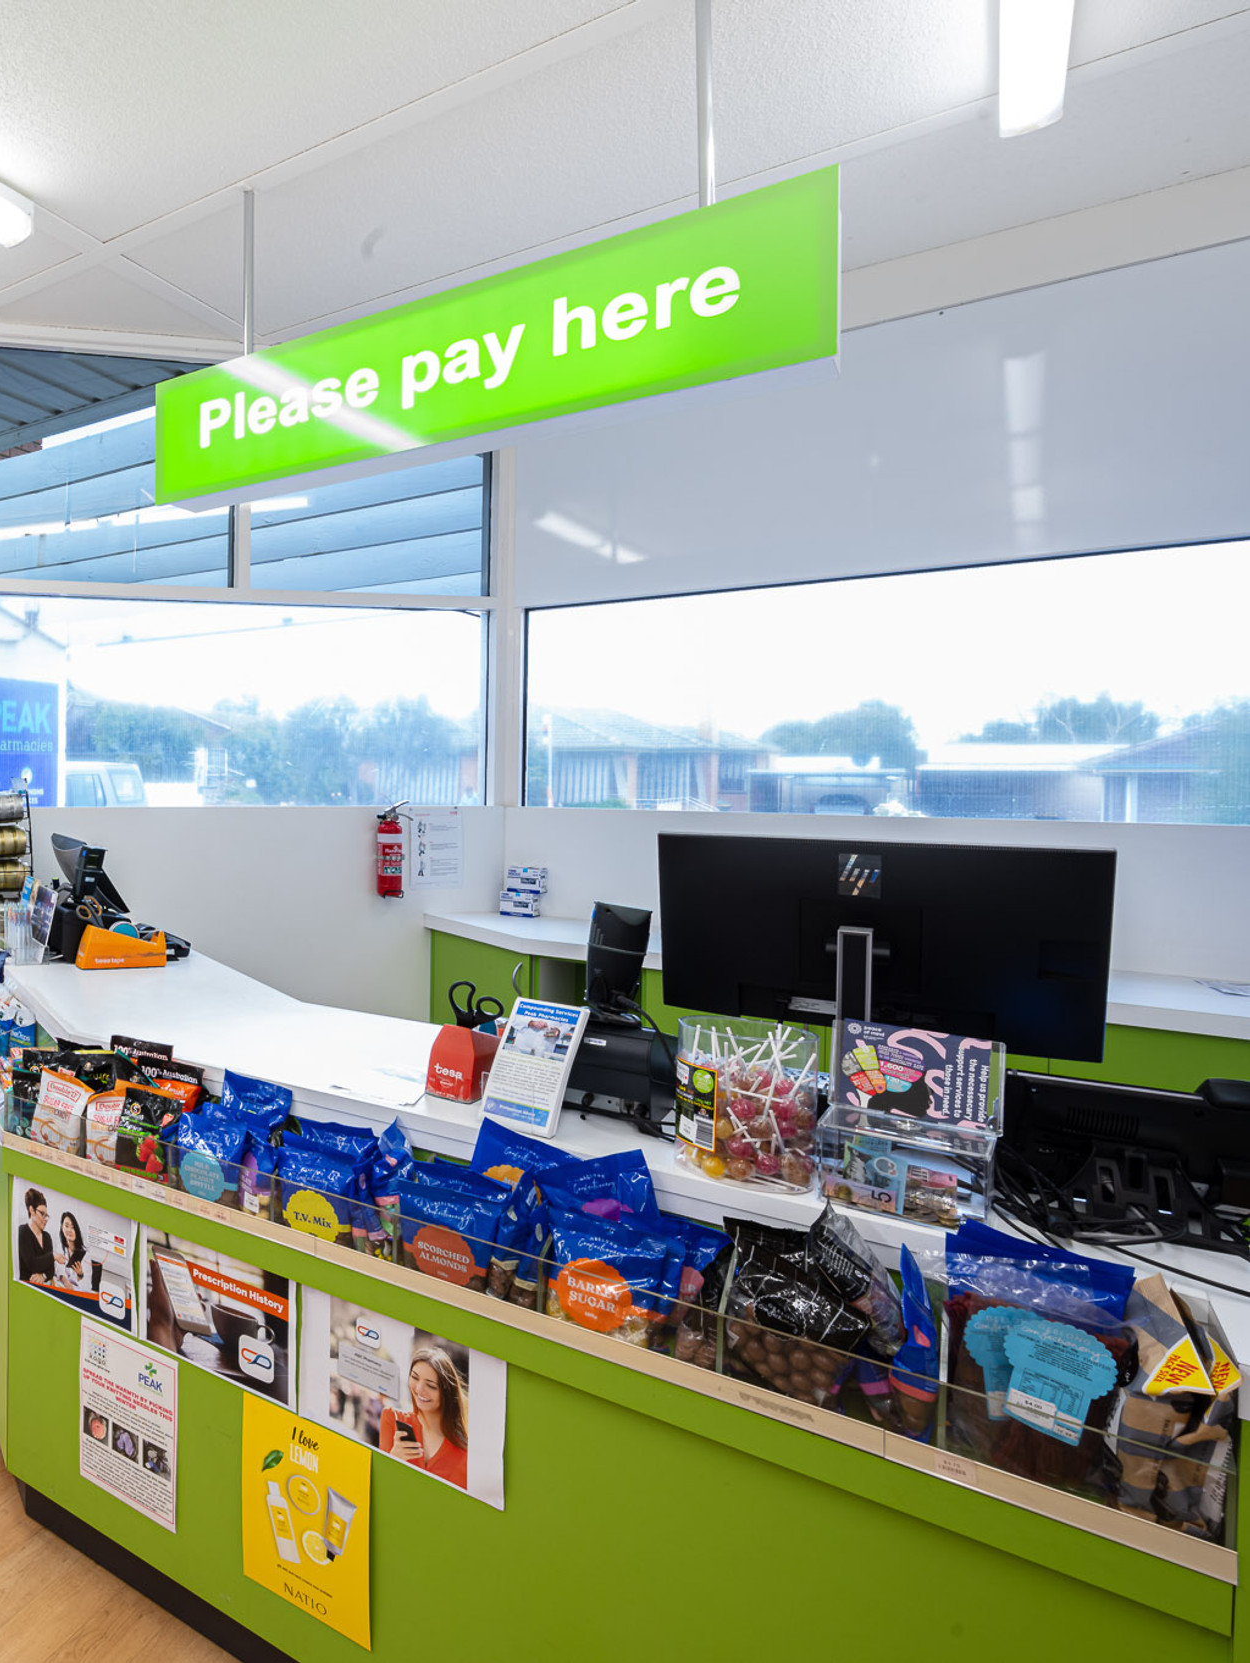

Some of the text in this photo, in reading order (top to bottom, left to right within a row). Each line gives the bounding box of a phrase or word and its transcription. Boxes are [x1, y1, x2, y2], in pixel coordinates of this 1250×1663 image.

[198, 264, 742, 449] Please pay here
[519, 1003, 579, 1018] Compounding Services
[538, 1013, 569, 1023] Pharmacies
[162, 1069, 198, 1085] Australian
[434, 1063, 463, 1080] tesa
[944, 1064, 954, 1086] those
[969, 1059, 978, 1072] the
[43, 1095, 61, 1109] SUGAR
[954, 1076, 964, 1110] services
[978, 1065, 989, 1123] Help us provide
[954, 1109, 963, 1118] to
[184, 1165, 221, 1180] CHOCOLATE
[294, 1211, 332, 1229] T.V. Mix
[417, 1241, 470, 1264] SCORCHED
[419, 1251, 468, 1274] ALMONDS
[192, 1268, 284, 1313] Prescription History
[567, 1275, 623, 1301] BARLEY
[569, 1290, 616, 1314] SUGAR
[1163, 1353, 1182, 1370] PACK
[1165, 1360, 1199, 1385] NEW
[138, 1372, 163, 1392] PEAK
[1213, 1362, 1230, 1389] NEW
[83, 1367, 103, 1381] SPREAD
[104, 1378, 115, 1387] THE
[115, 1383, 139, 1400] WARMTH
[149, 1400, 174, 1416] PICKING
[91, 1378, 105, 1389] YOUR
[106, 1385, 132, 1402] KNITTING
[133, 1399, 159, 1415] NEEDLES
[159, 1412, 173, 1422] THIS
[115, 1396, 137, 1410] WINTER
[291, 1426, 320, 1451] I love
[290, 1443, 319, 1474] LEMON
[283, 1582, 327, 1616] NATIO
